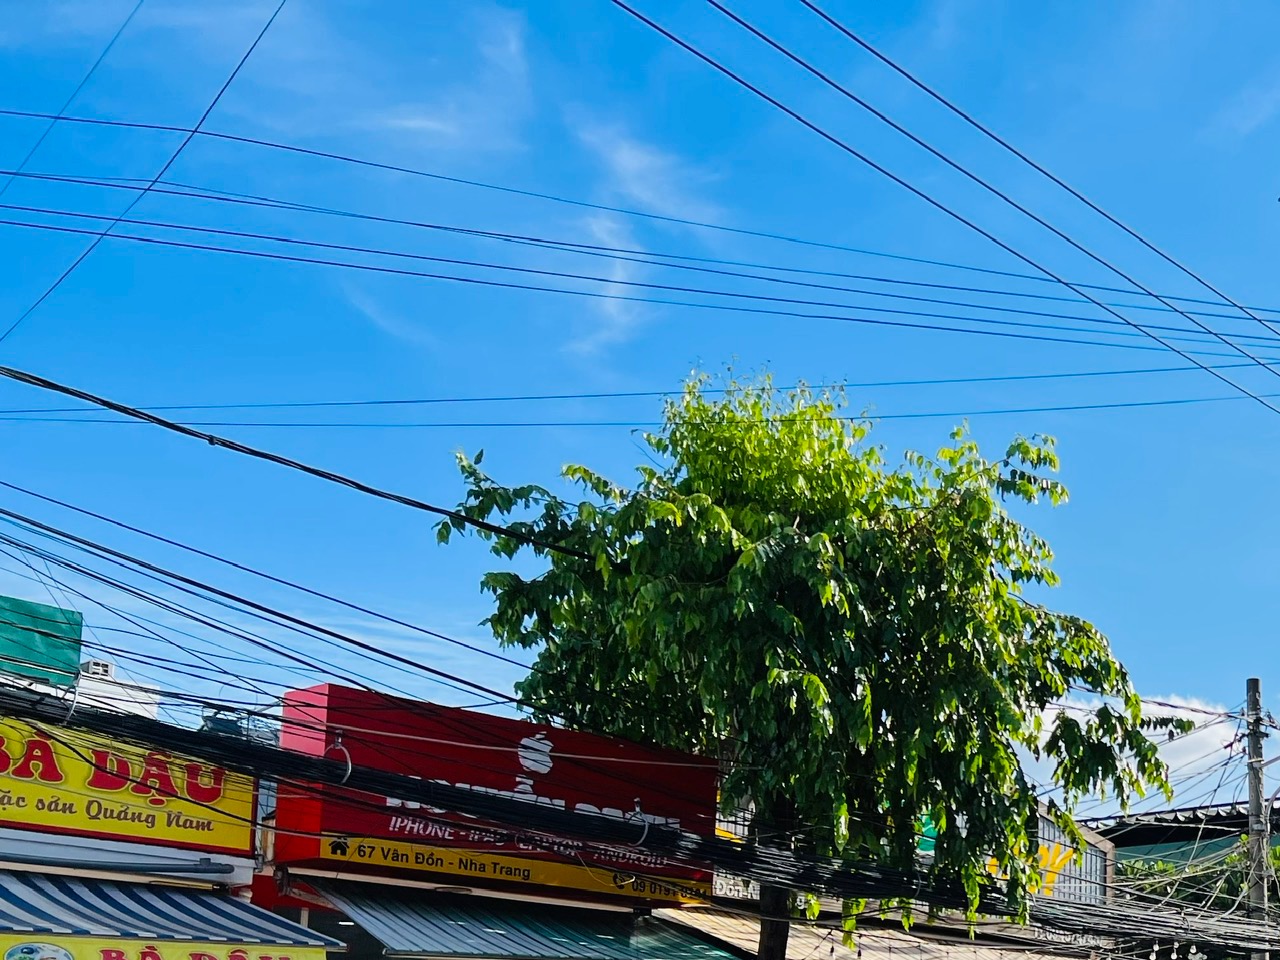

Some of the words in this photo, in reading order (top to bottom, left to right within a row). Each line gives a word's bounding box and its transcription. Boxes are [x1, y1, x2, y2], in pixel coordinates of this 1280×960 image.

[86, 750, 227, 807] DẬU
[35, 795, 77, 815] sản
[85, 799, 157, 829] Quảng
[166, 810, 214, 832] Nam
[357, 845, 376, 858] 67
[380, 849, 409, 863] Vân
[415, 852, 444, 868] Đồn
[458, 859, 487, 873] Nha
[491, 863, 531, 880] Trang
